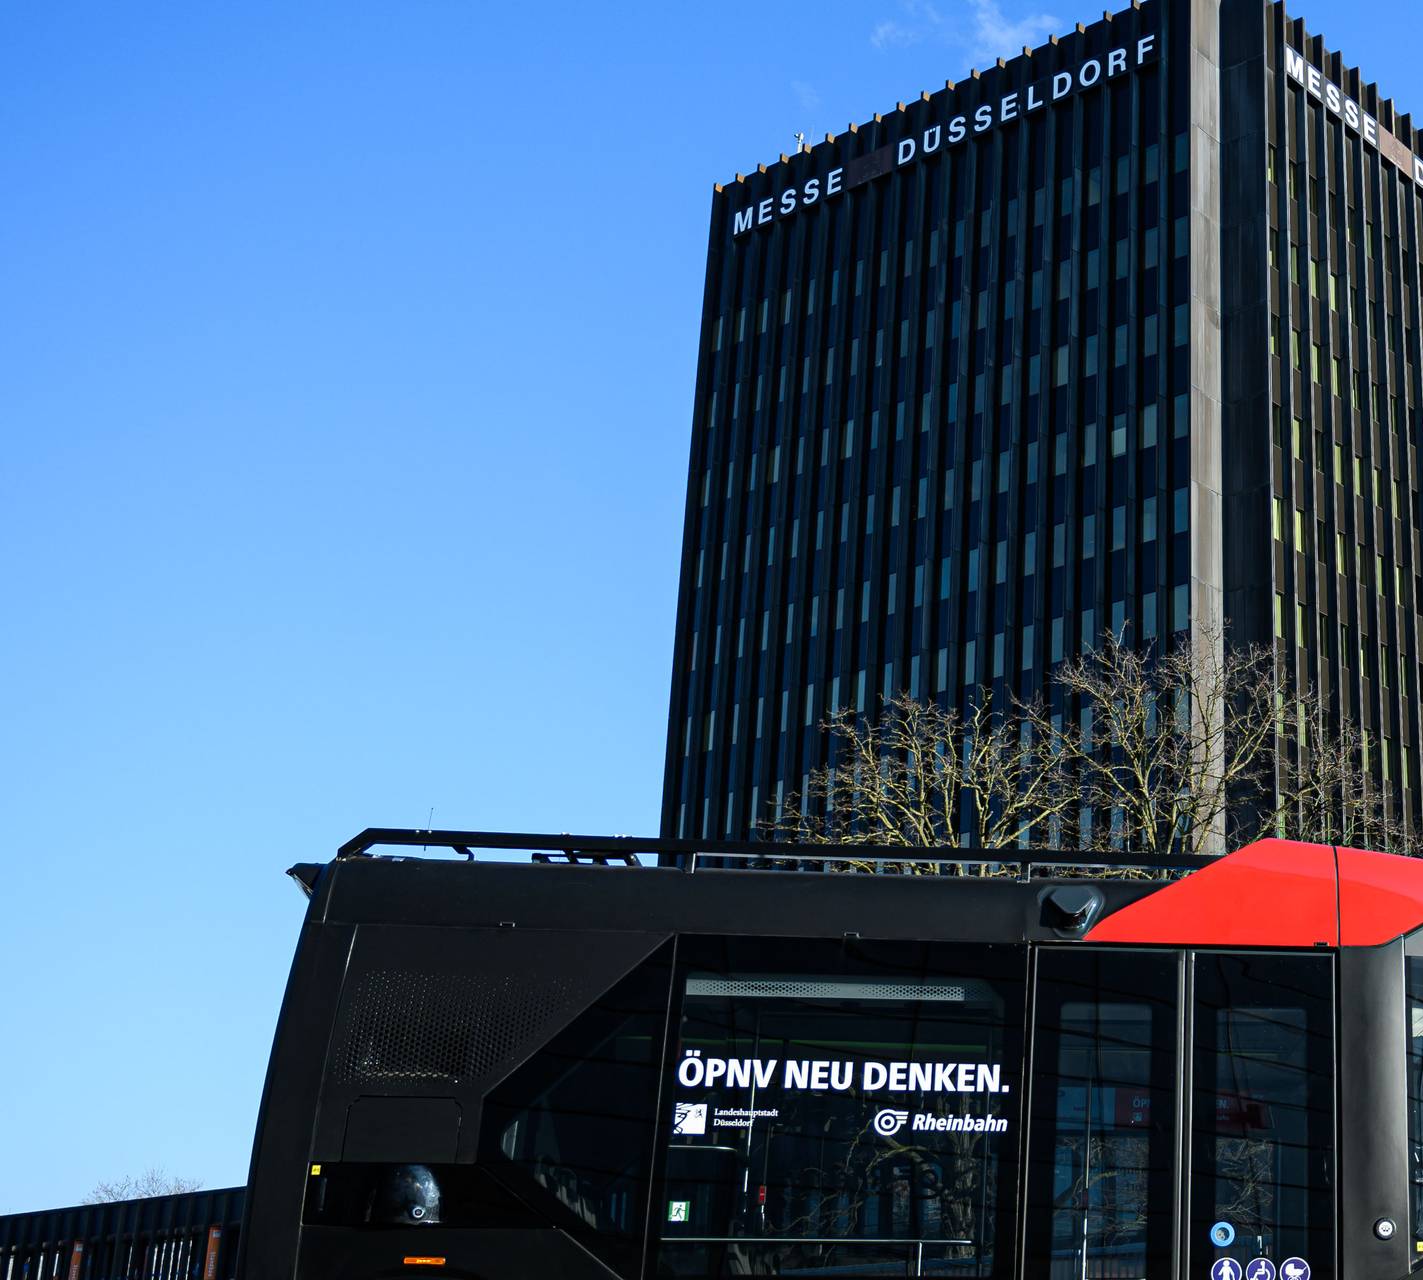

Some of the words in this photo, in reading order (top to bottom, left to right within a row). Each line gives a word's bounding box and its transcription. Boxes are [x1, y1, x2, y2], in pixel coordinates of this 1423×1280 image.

[1286, 47, 1378, 145] MESSE
[733, 166, 844, 236] MESSE
[897, 34, 1155, 166] DÜSSELDORF
[678, 1049, 777, 1088] ÖPNV
[784, 1060, 854, 1090] NEU
[863, 1062, 1010, 1093] DENKEN.
[713, 1118, 755, 1127] Düsseldorf
[714, 1108, 779, 1118] Landeshauptstadt
[912, 1113, 1008, 1132] Rheinbahn
